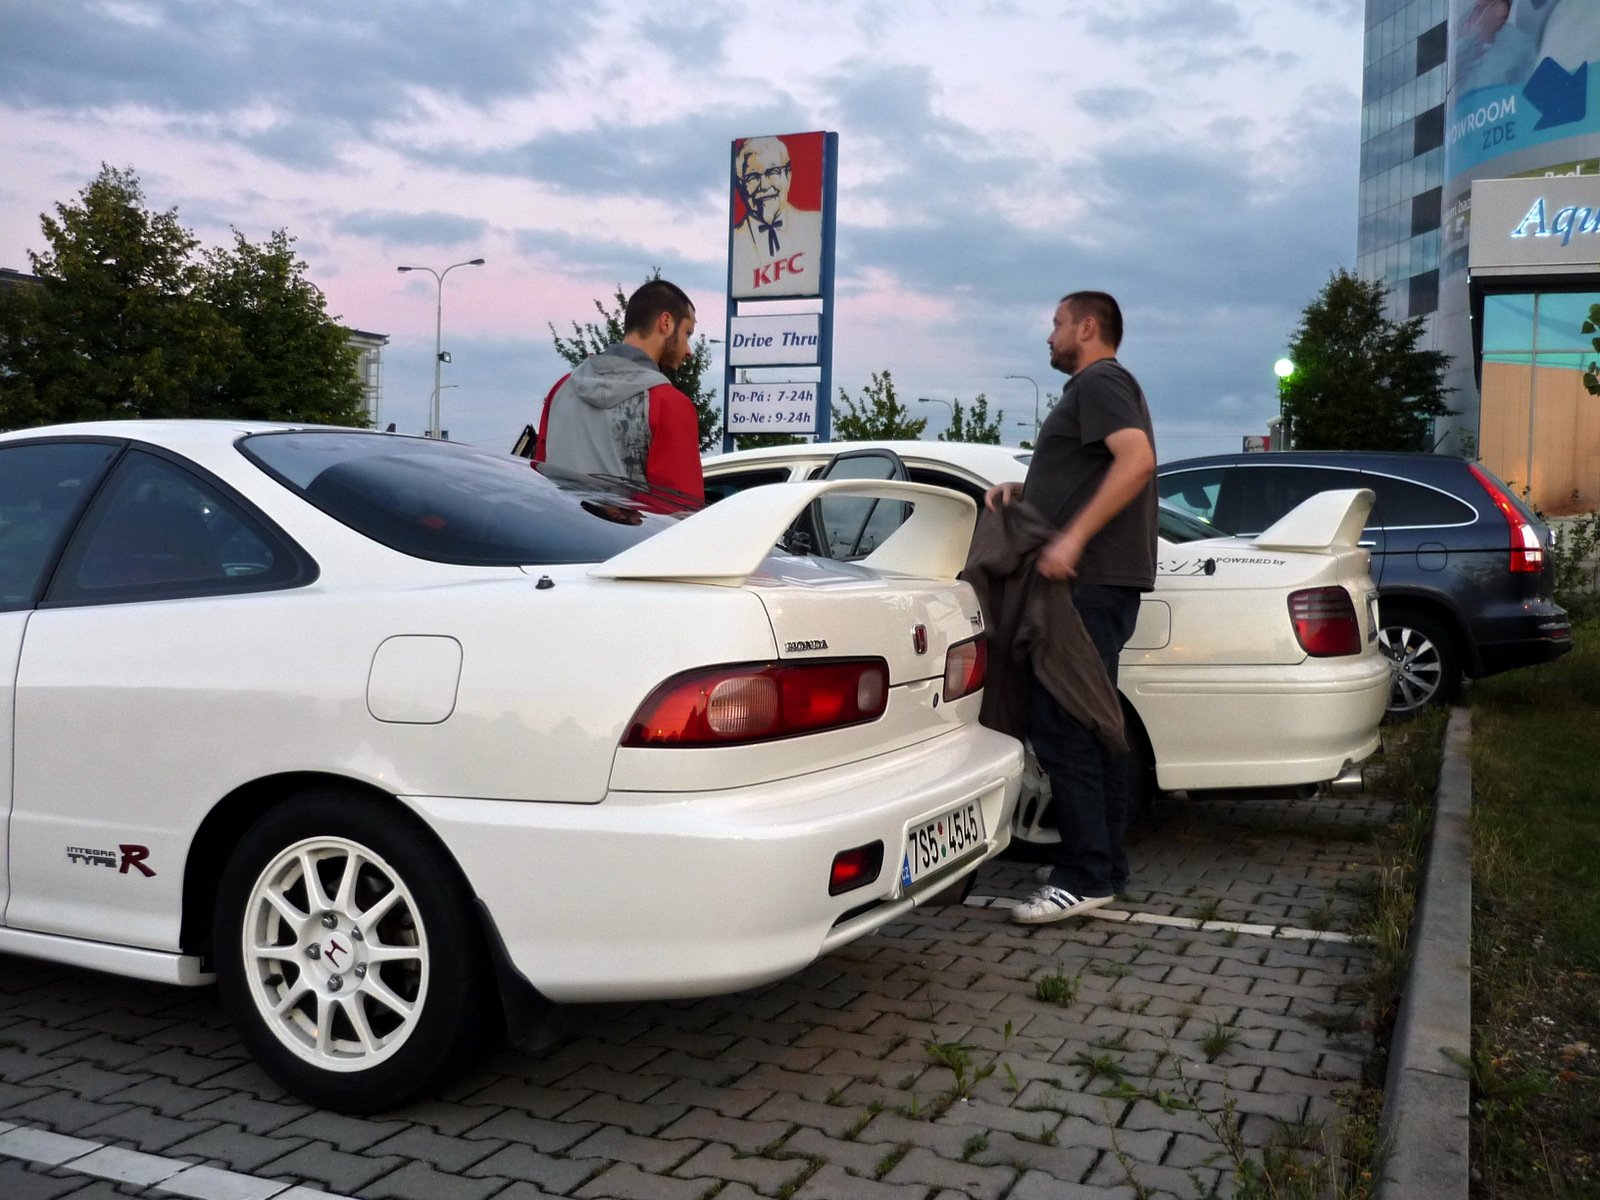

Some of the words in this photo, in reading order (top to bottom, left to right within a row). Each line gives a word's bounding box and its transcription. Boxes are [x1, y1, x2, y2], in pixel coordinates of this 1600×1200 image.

[1482, 121, 1515, 150] ZDE
[753, 252, 804, 289] KFC
[732, 333, 773, 348] Drive
[782, 332, 817, 346] Thru
[777, 390, 813, 402] 7-24h
[775, 412, 811, 423] 9-24h
[1216, 557, 1271, 565] POWERED
[784, 639, 828, 652] HONDA
[909, 824, 939, 874] 7S5
[948, 805, 978, 853] 4545
[67, 846, 116, 857] INTEGRA
[67, 853, 117, 868] TYPE
[119, 844, 157, 877] R
